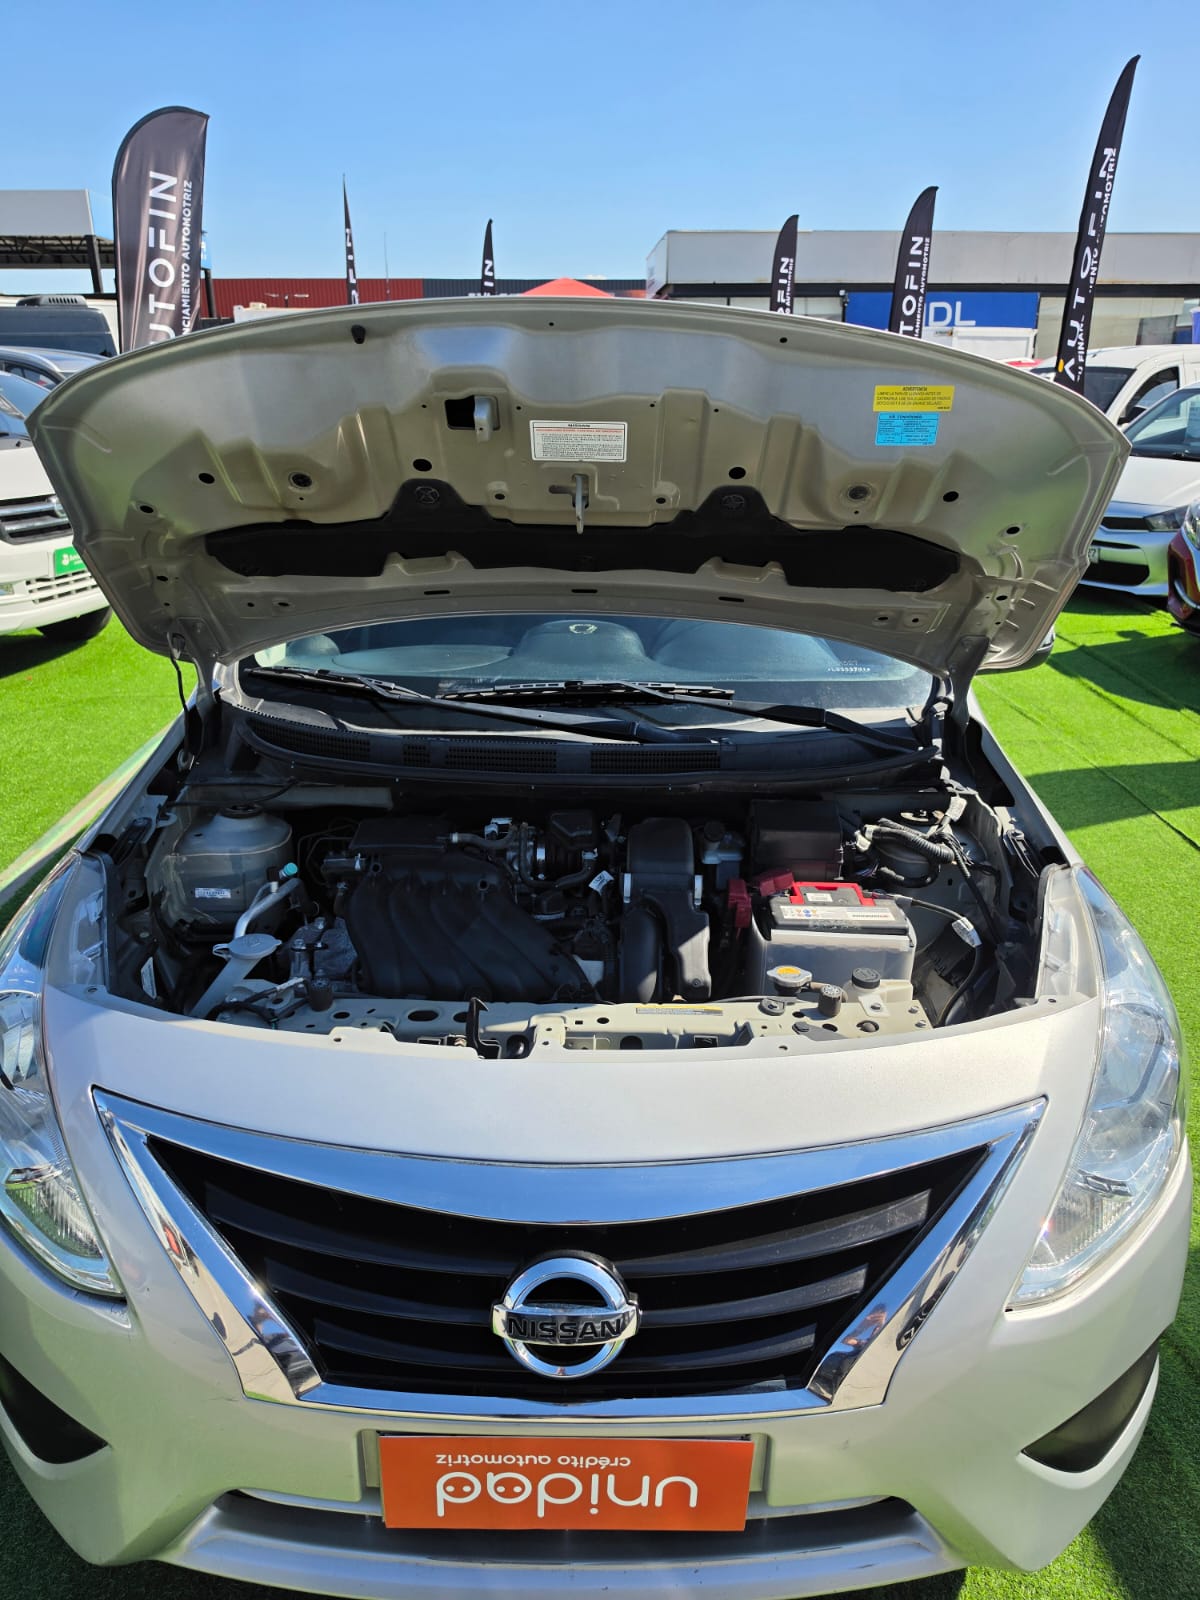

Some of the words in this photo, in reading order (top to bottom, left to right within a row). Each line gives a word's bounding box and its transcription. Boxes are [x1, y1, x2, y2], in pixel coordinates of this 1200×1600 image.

[181, 180, 193, 259] AUTOMOTRIZ
[507, 1317, 623, 1340] NISSAN
[435, 1453, 552, 1468] automotriz
[557, 1454, 632, 1470] crédito
[435, 1471, 699, 1519] unidad
